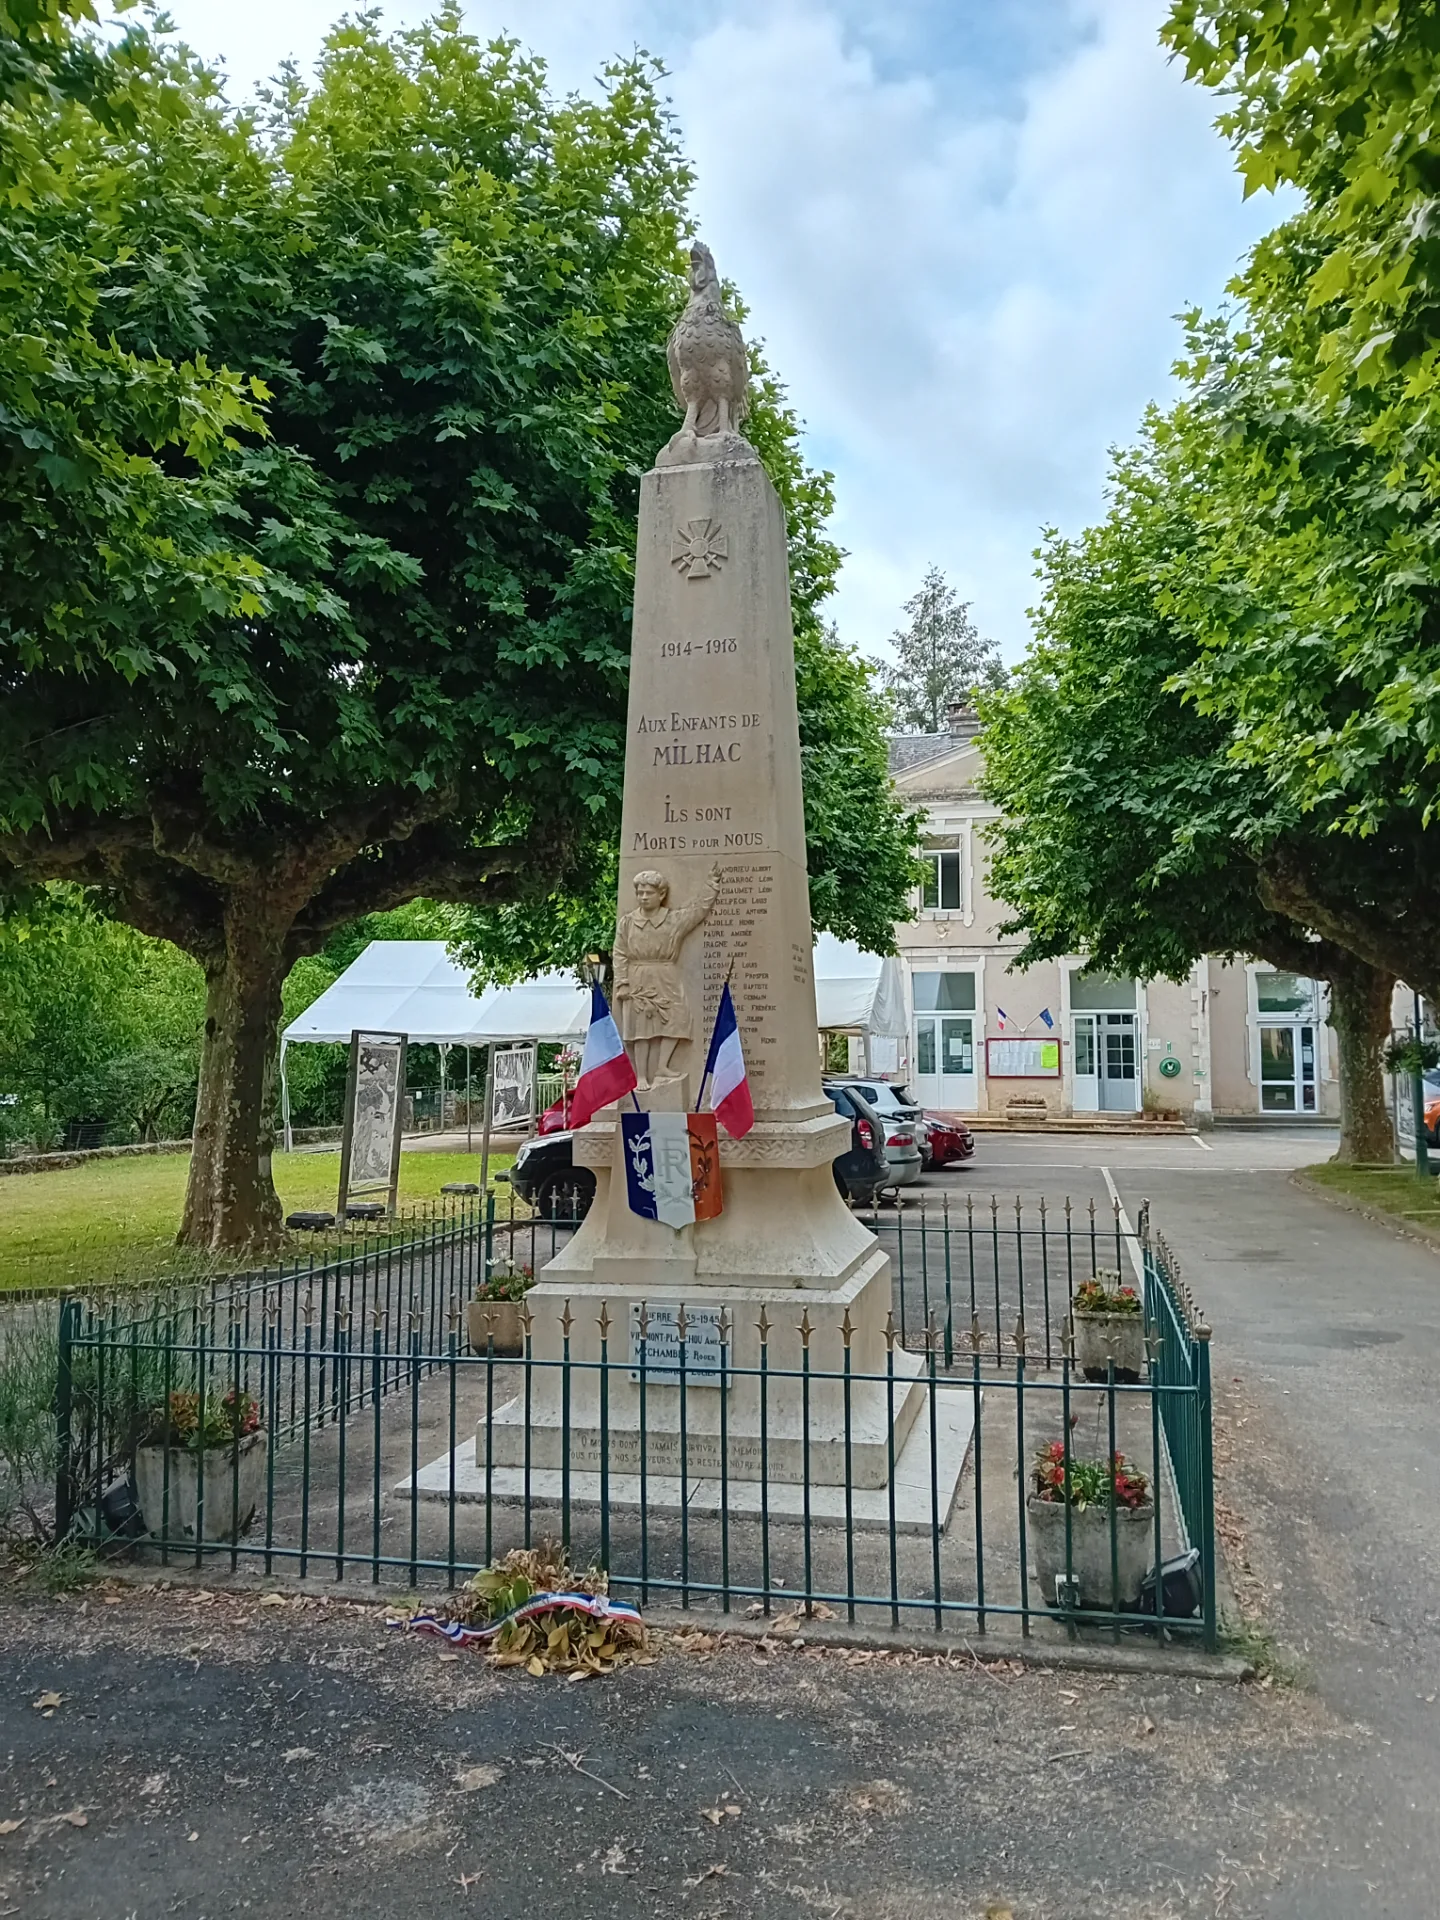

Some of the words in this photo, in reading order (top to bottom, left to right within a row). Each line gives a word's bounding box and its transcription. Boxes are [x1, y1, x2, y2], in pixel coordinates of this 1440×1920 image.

[660, 638, 738, 657] 1914-1918
[637, 714, 667, 734] AUX
[671, 712, 737, 732] ENFANTS
[742, 713, 761, 728] DE
[695, 807, 732, 821] SONT
[632, 832, 687, 851] MORTS
[692, 840, 719, 849] POUR
[724, 832, 764, 847] NOUS
